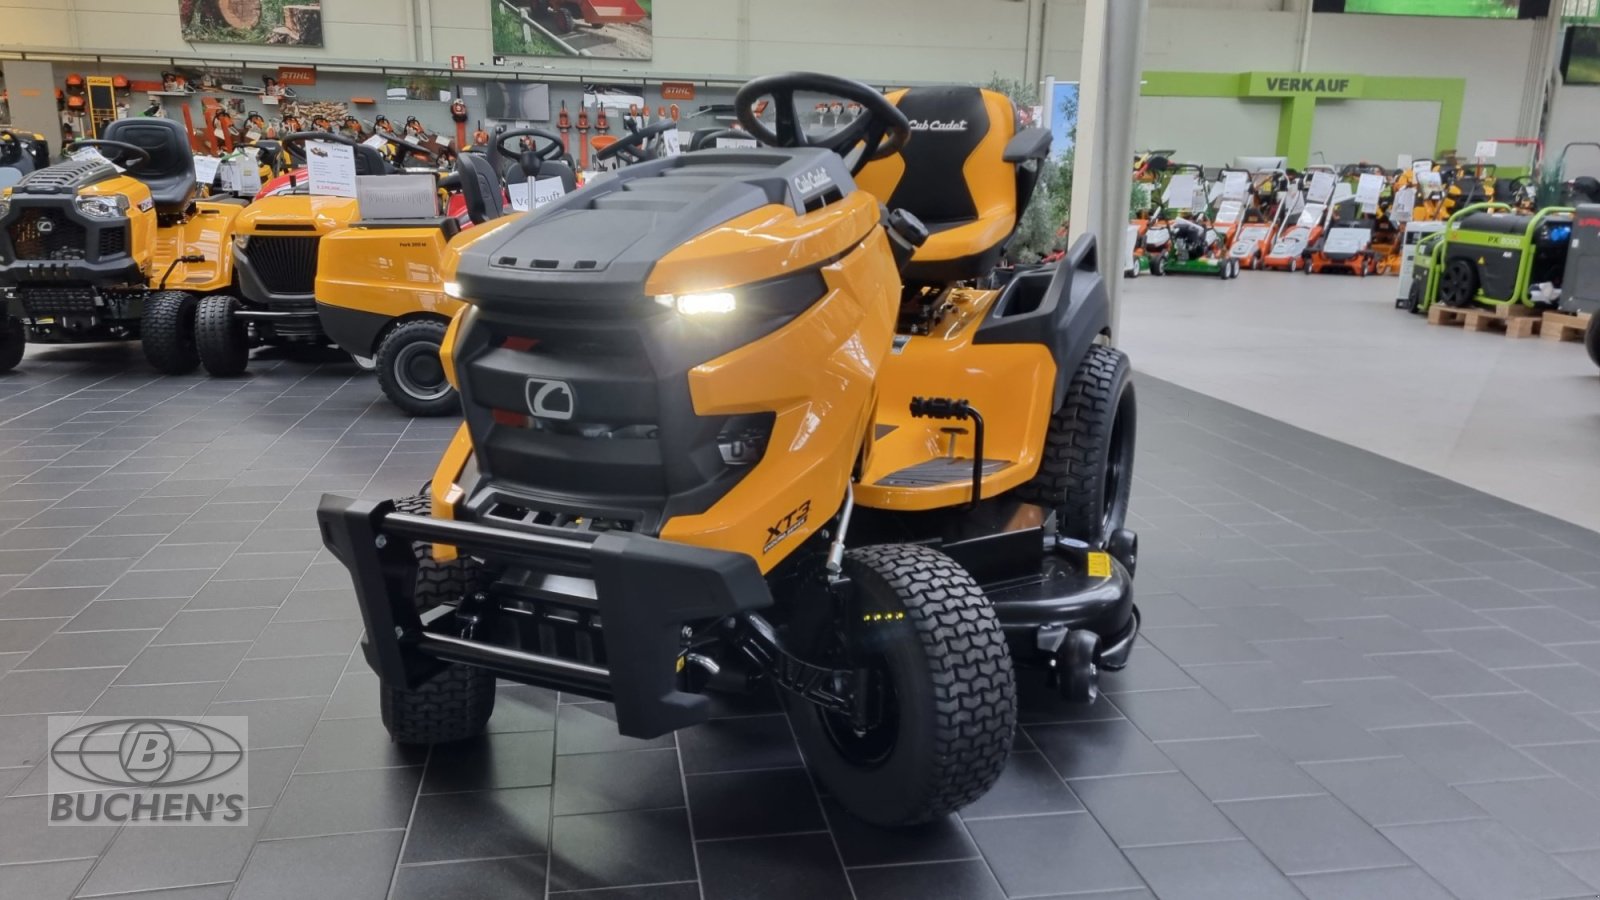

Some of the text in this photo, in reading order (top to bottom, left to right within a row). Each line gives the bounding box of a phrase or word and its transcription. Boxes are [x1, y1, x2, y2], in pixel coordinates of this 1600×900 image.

[281, 71, 310, 80] STIHL
[664, 86, 691, 95] STIHL
[1266, 77, 1350, 92] VERKAUF
[908, 119, 968, 131] Cub Cadet
[515, 191, 561, 206] Vekauft
[764, 499, 811, 545] XT3
